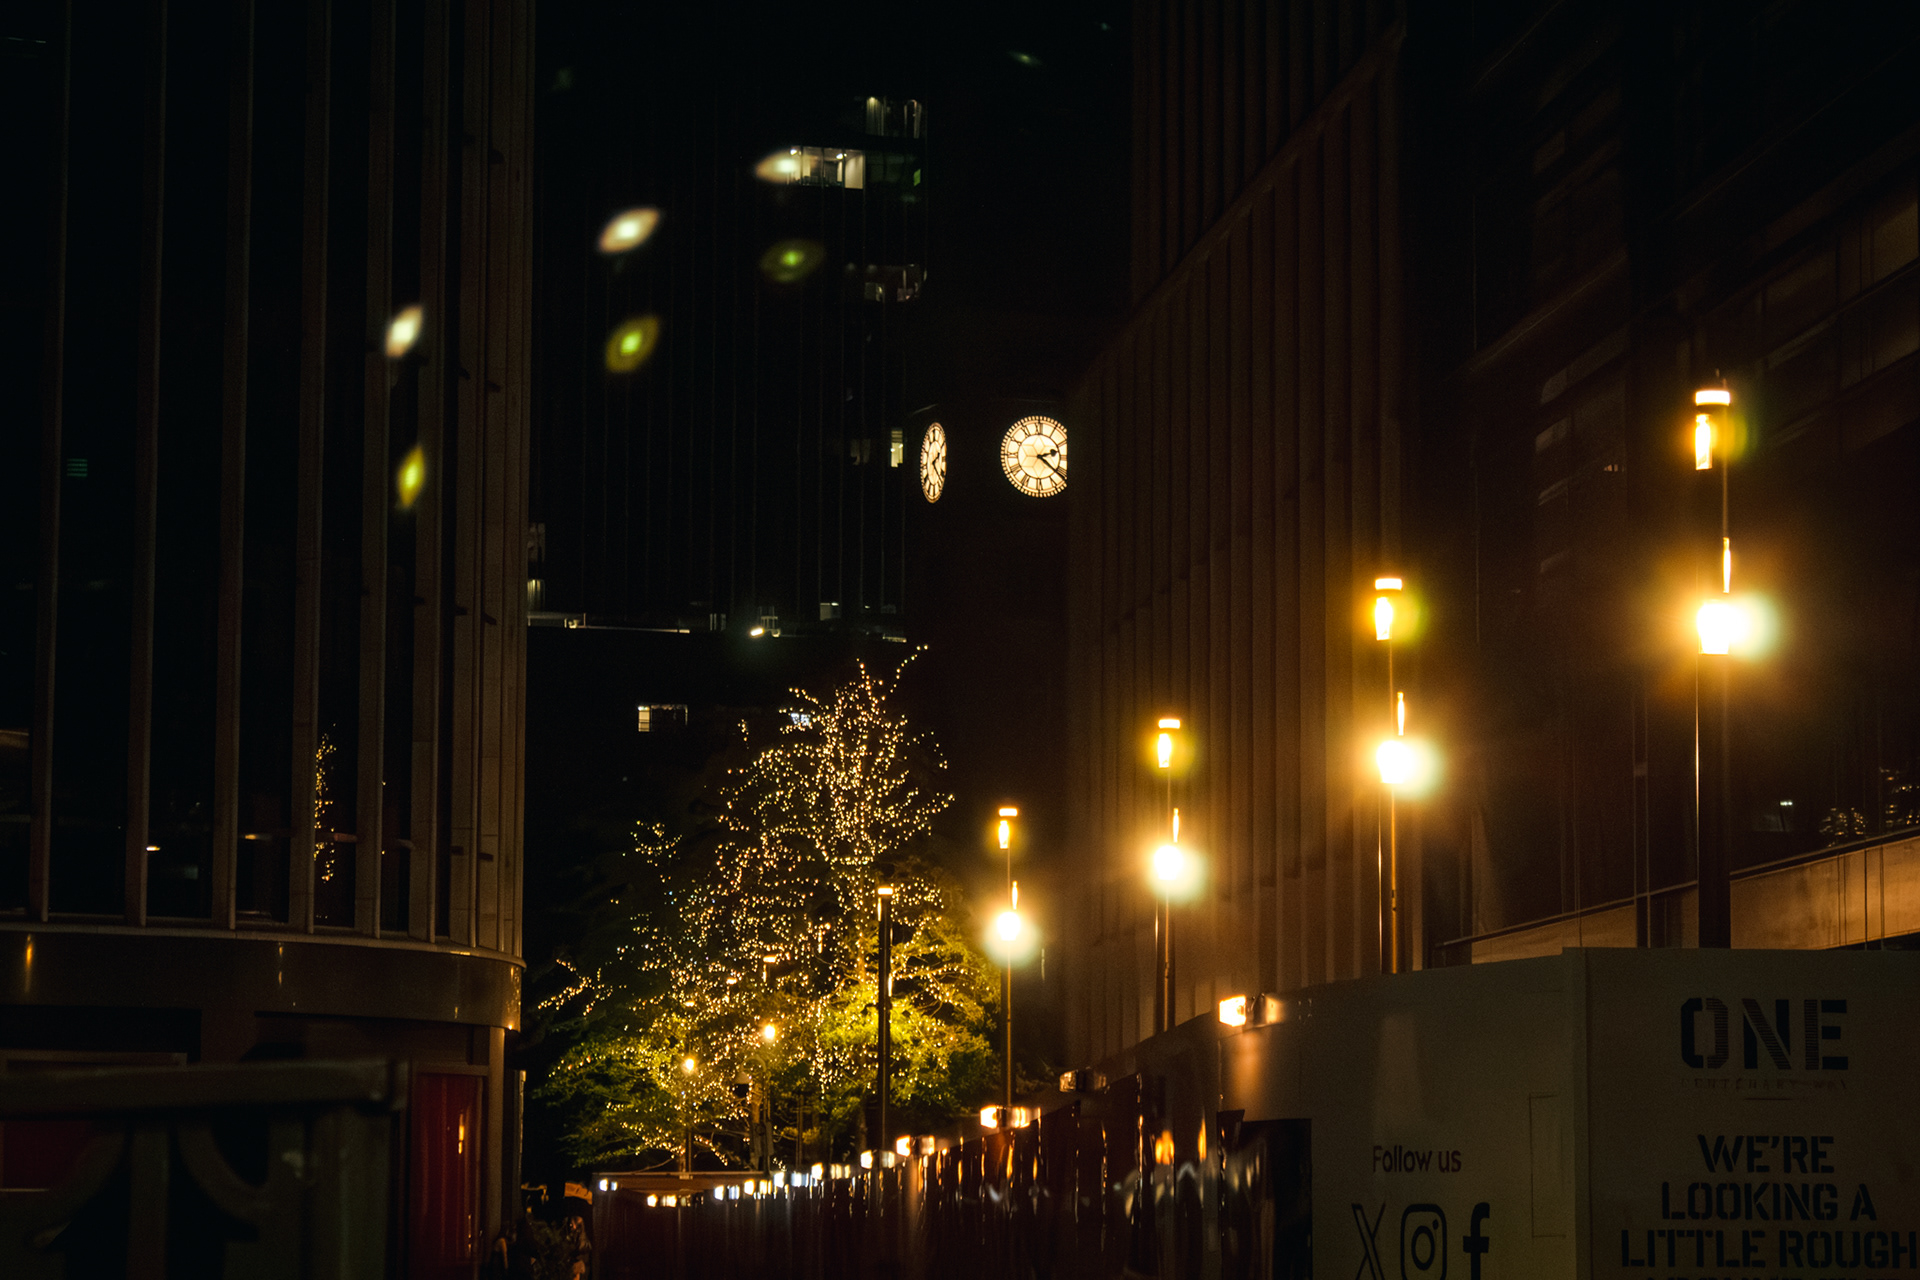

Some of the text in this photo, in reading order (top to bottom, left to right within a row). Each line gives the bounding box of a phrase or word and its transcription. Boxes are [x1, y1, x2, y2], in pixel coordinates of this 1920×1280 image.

[1681, 998, 1849, 1070] ONE
[1372, 1145, 1462, 1173] Follow us
[1697, 1134, 1835, 1173] WE'RE
[1661, 1182, 1877, 1221] LOOKING A
[1621, 1229, 1916, 1269] LITTLE ROUGH
